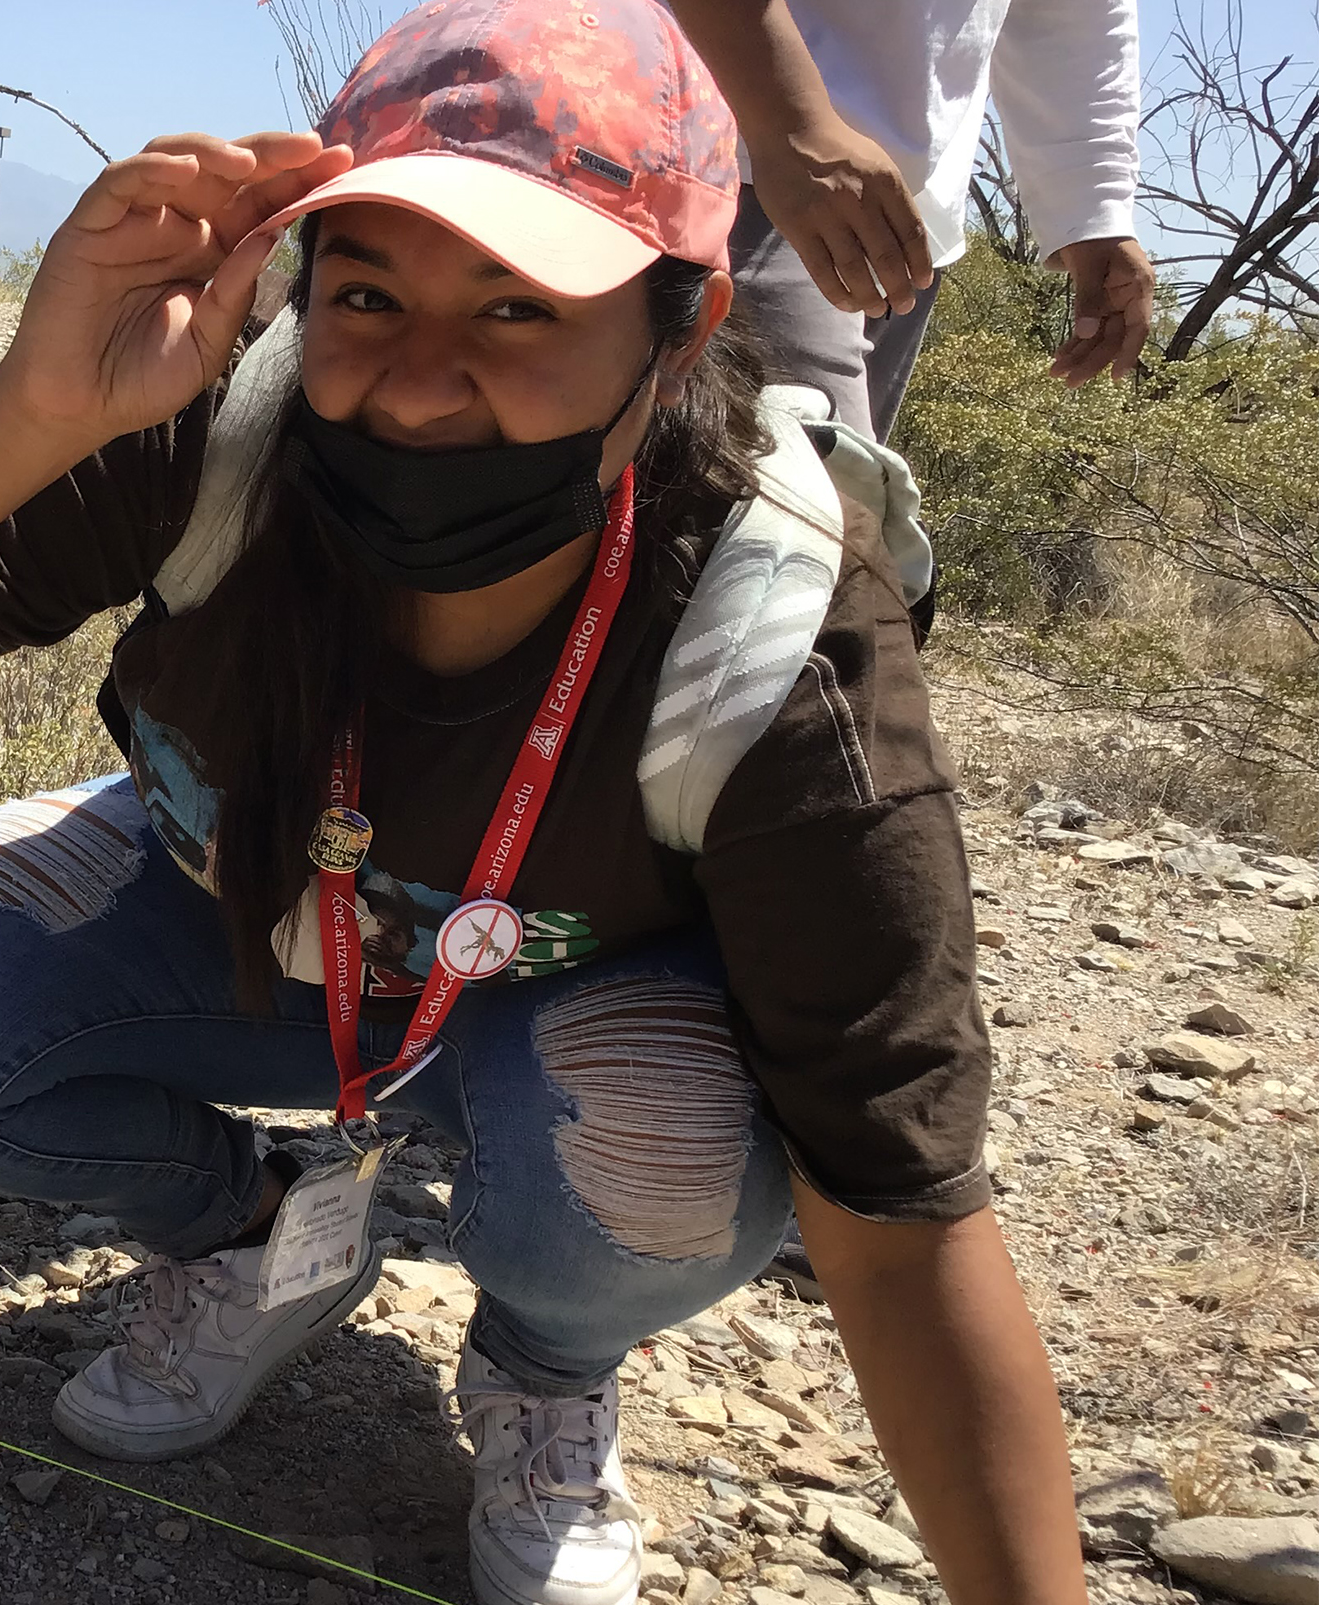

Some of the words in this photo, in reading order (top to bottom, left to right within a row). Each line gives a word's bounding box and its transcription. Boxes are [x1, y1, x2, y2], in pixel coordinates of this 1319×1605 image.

[548, 605, 602, 714] Education
[603, 503, 634, 578] coe.ariz
[481, 782, 534, 901] oe.arizona.edu
[332, 900, 354, 1023] coe.arizona.edu
[419, 968, 458, 1026] Educa
